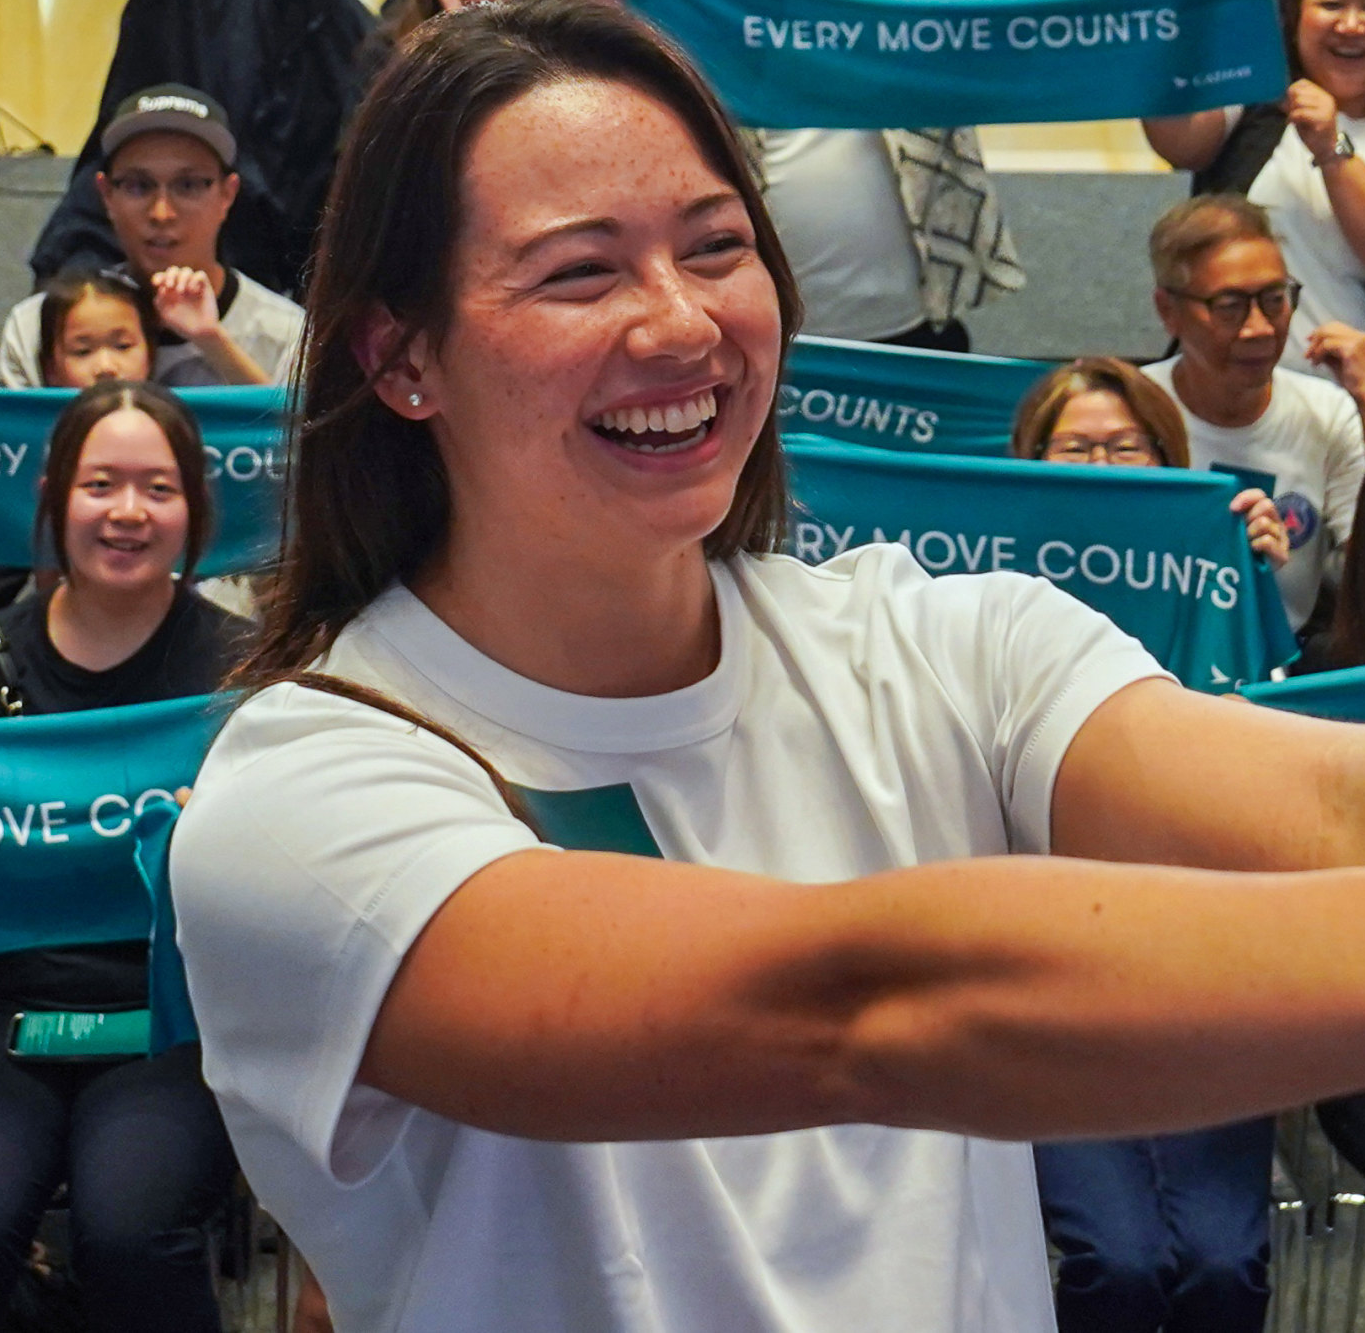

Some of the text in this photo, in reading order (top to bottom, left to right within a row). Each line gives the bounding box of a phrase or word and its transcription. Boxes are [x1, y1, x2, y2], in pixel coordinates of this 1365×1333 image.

[742, 8, 1180, 51] EVERY MOVE COUNTS
[137, 95, 209, 119] Supreme
[1037, 540, 1241, 609] COUNTS
